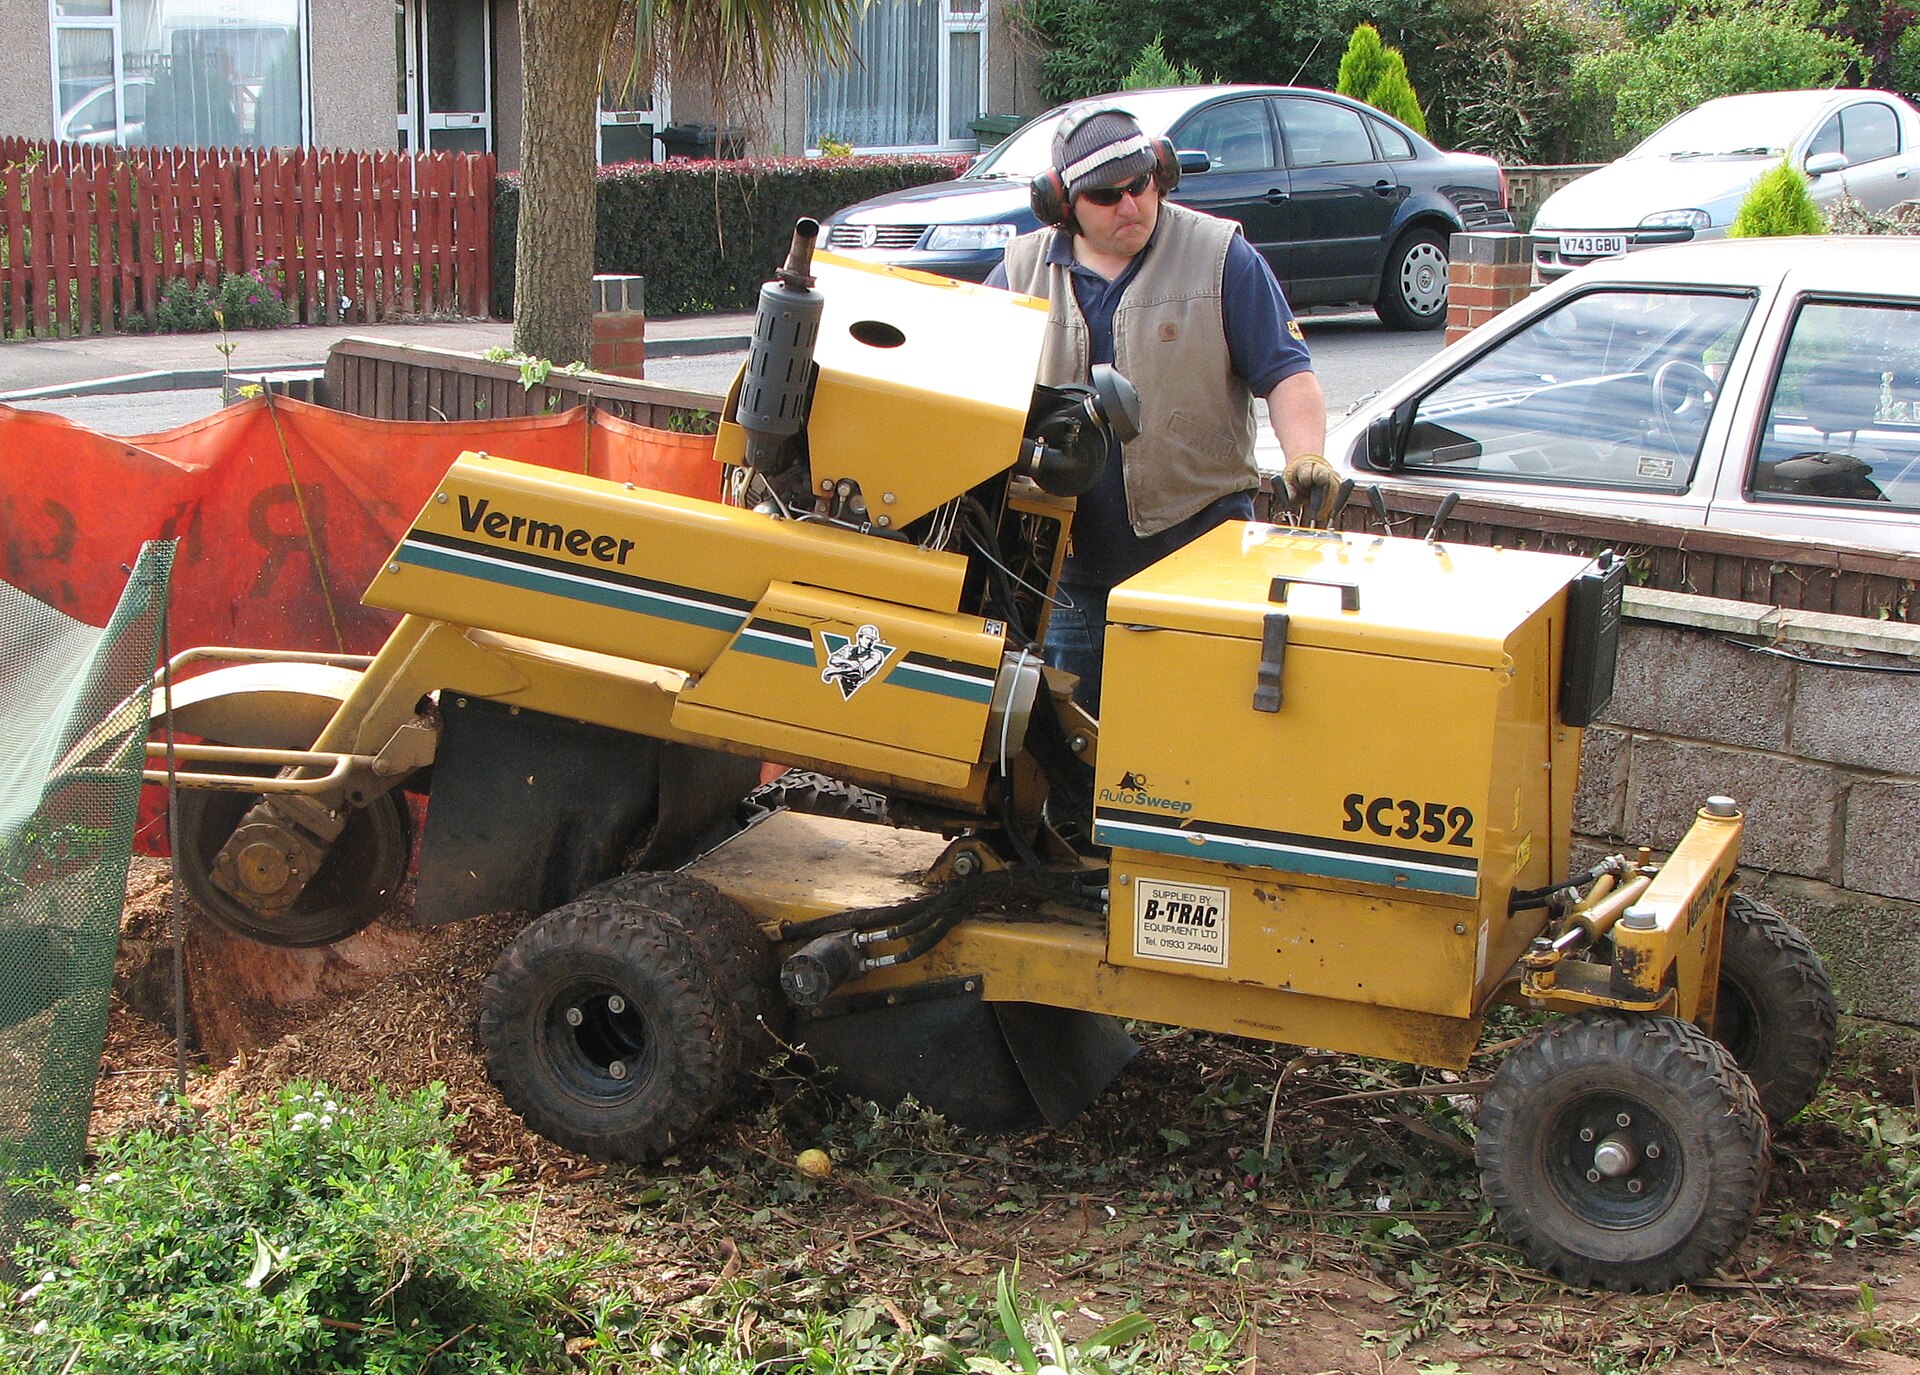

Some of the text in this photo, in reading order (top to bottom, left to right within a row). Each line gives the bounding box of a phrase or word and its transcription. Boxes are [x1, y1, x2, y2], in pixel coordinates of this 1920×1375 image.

[1563, 238, 1621, 252] V743 GBU
[458, 494, 636, 566] Vermeer
[1342, 793, 1474, 848] SC352
[1152, 890, 1212, 904] SUPPLIED BY
[1144, 899, 1218, 927] B-TRAC
[1144, 922, 1218, 939] EQUIPMENT LTD
[1144, 937, 1157, 945] Tel.
[1160, 939, 1185, 949] 01933
